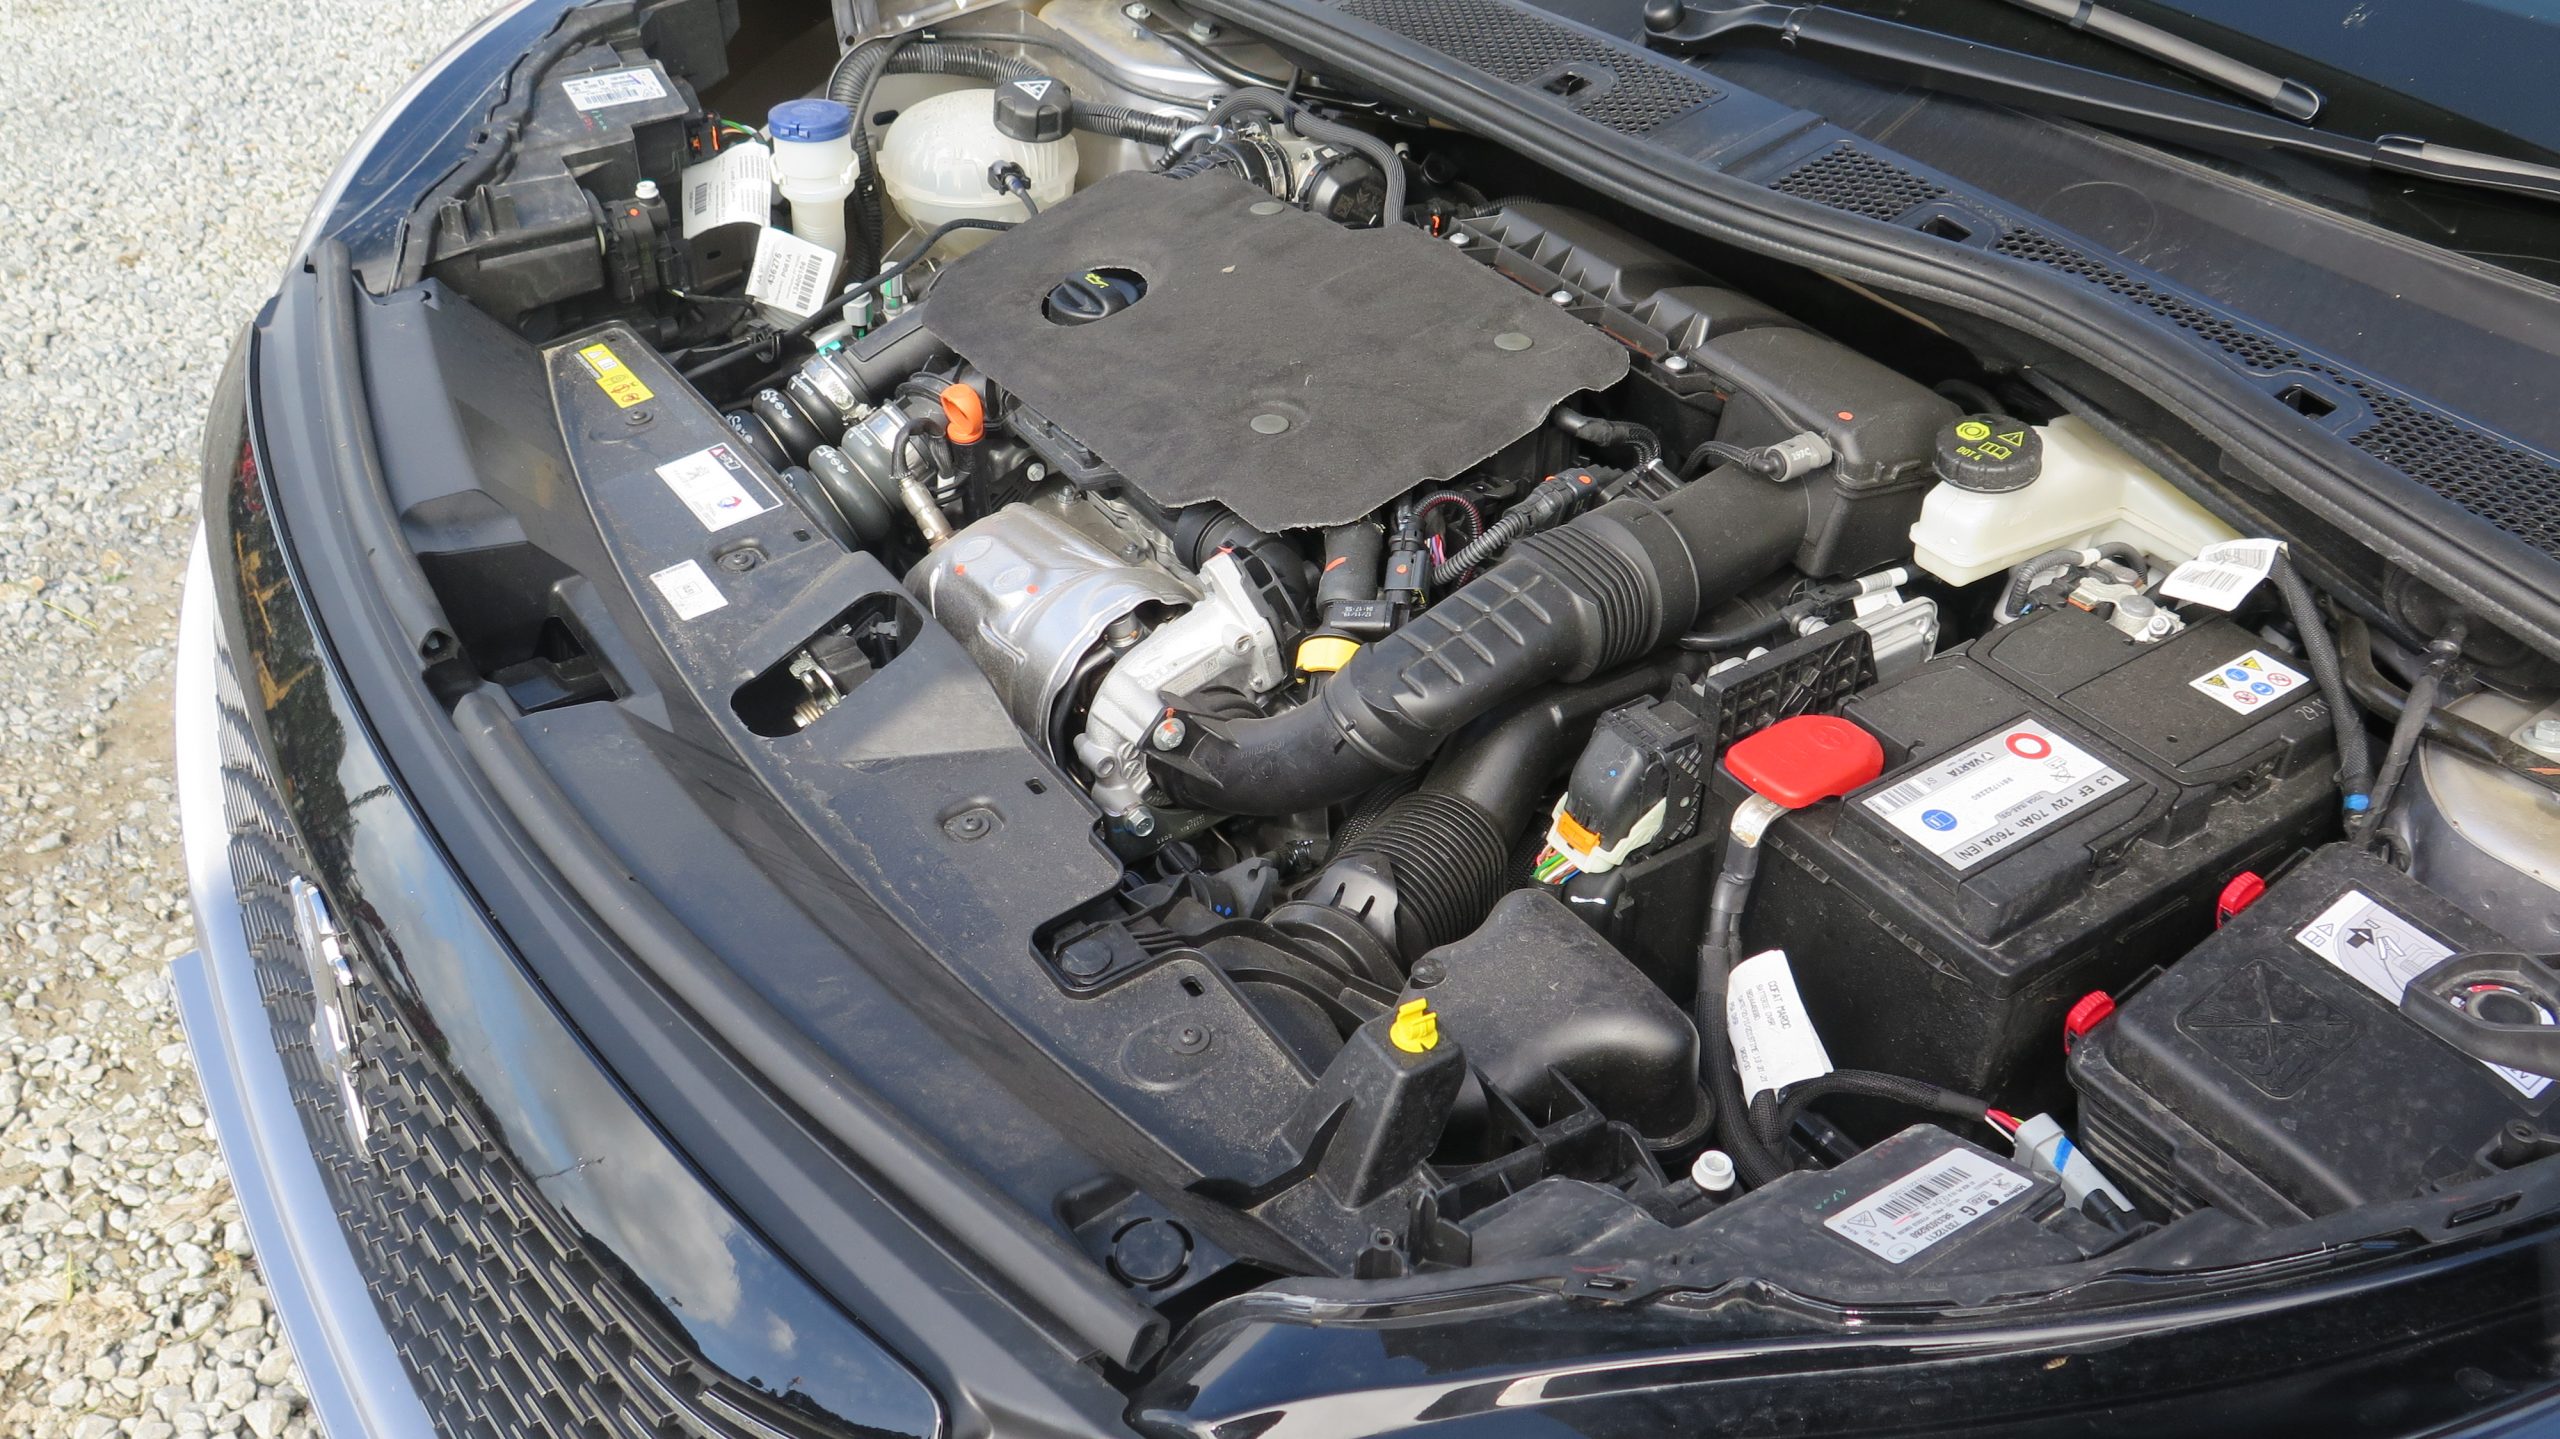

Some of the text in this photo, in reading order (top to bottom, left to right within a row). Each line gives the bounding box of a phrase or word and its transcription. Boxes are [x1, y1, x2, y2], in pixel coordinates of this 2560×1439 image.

[1956, 446, 1976, 457] DOT
[1946, 756, 1983, 778] VARTA
[1954, 774, 2114, 860] L3 EF 12V 70Ah 760A (EN)
[1959, 1205, 1978, 1216] G
